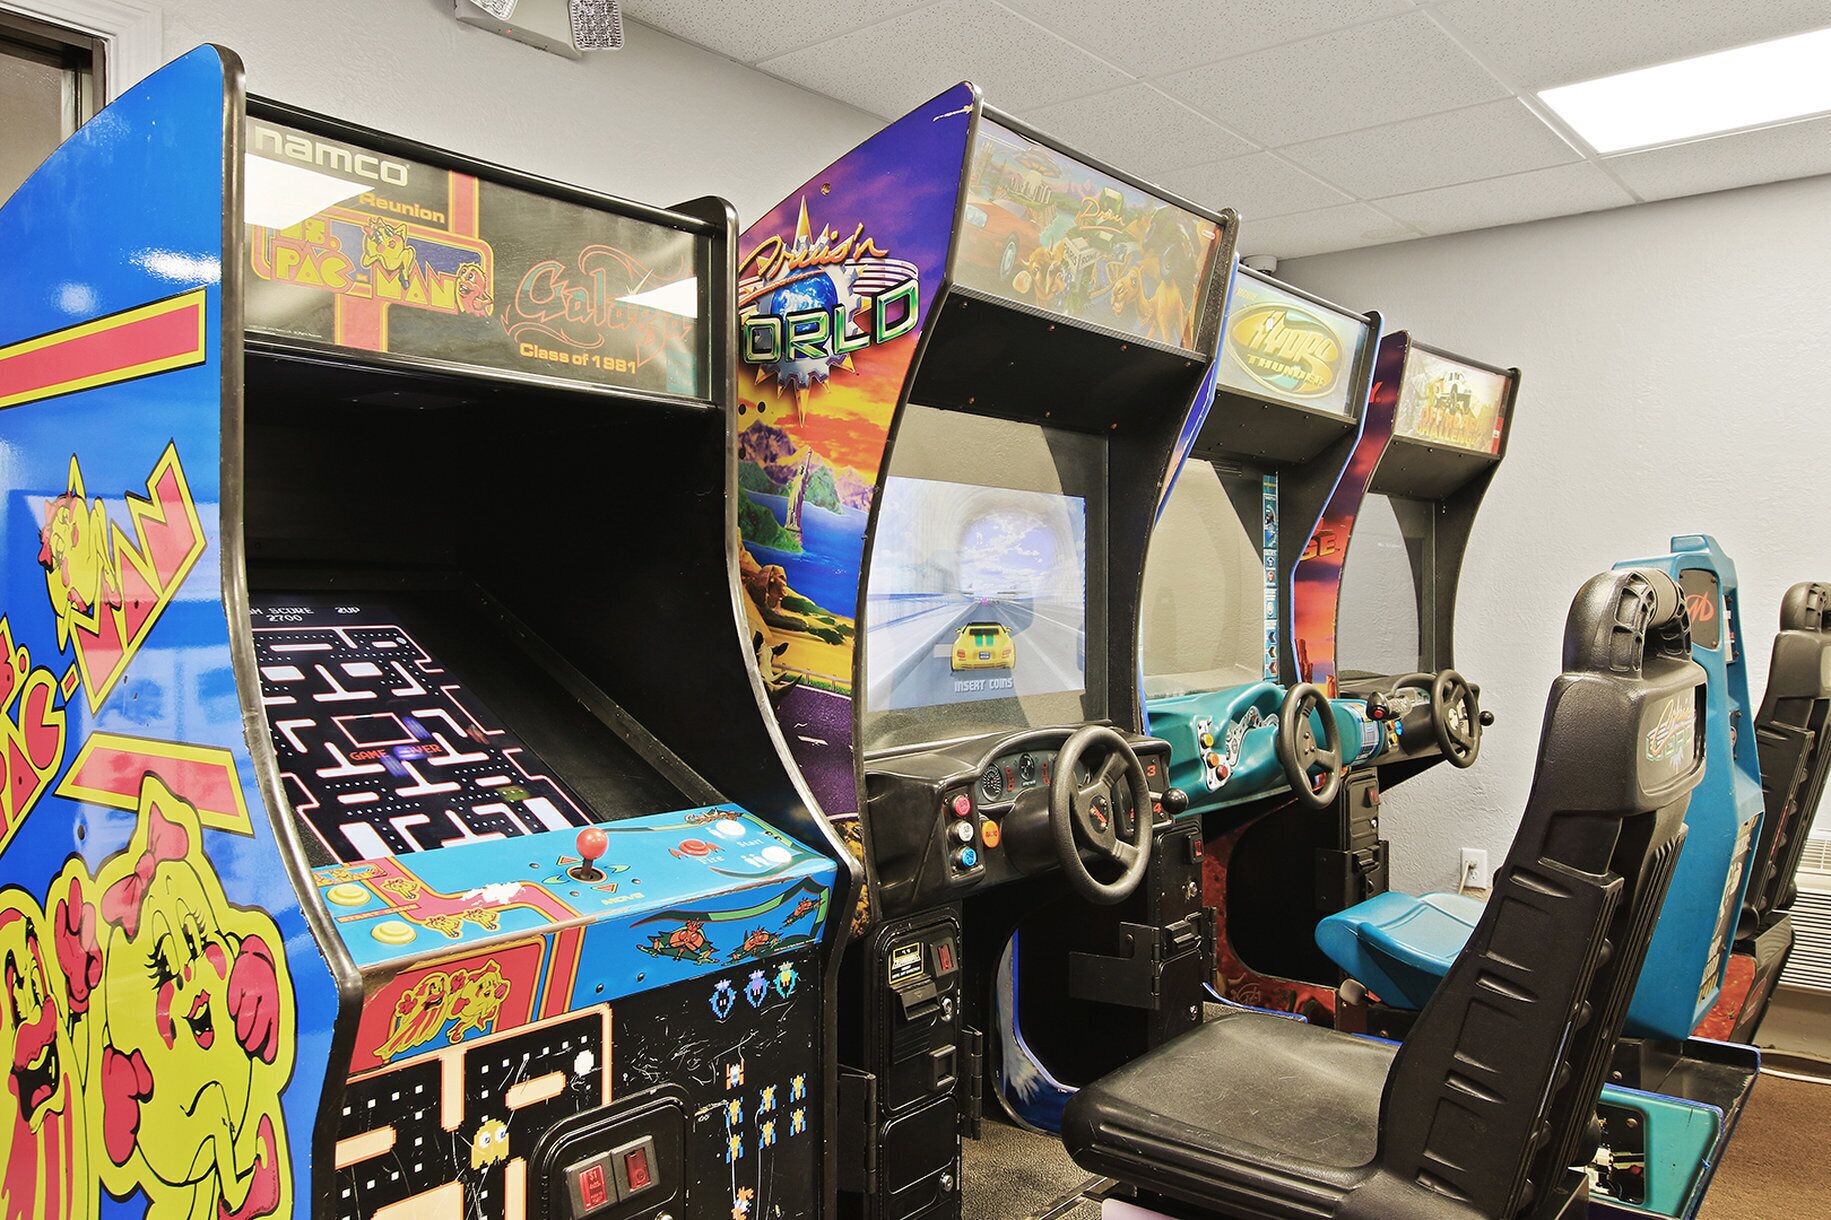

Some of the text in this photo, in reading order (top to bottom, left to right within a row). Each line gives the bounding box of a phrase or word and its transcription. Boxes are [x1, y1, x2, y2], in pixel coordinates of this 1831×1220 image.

[254, 126, 410, 188] namco
[359, 191, 446, 224] Reunion
[519, 342, 637, 375] Class of 1981
[954, 677, 1014, 694] INSERT COINS
[349, 748, 389, 761] GAME
